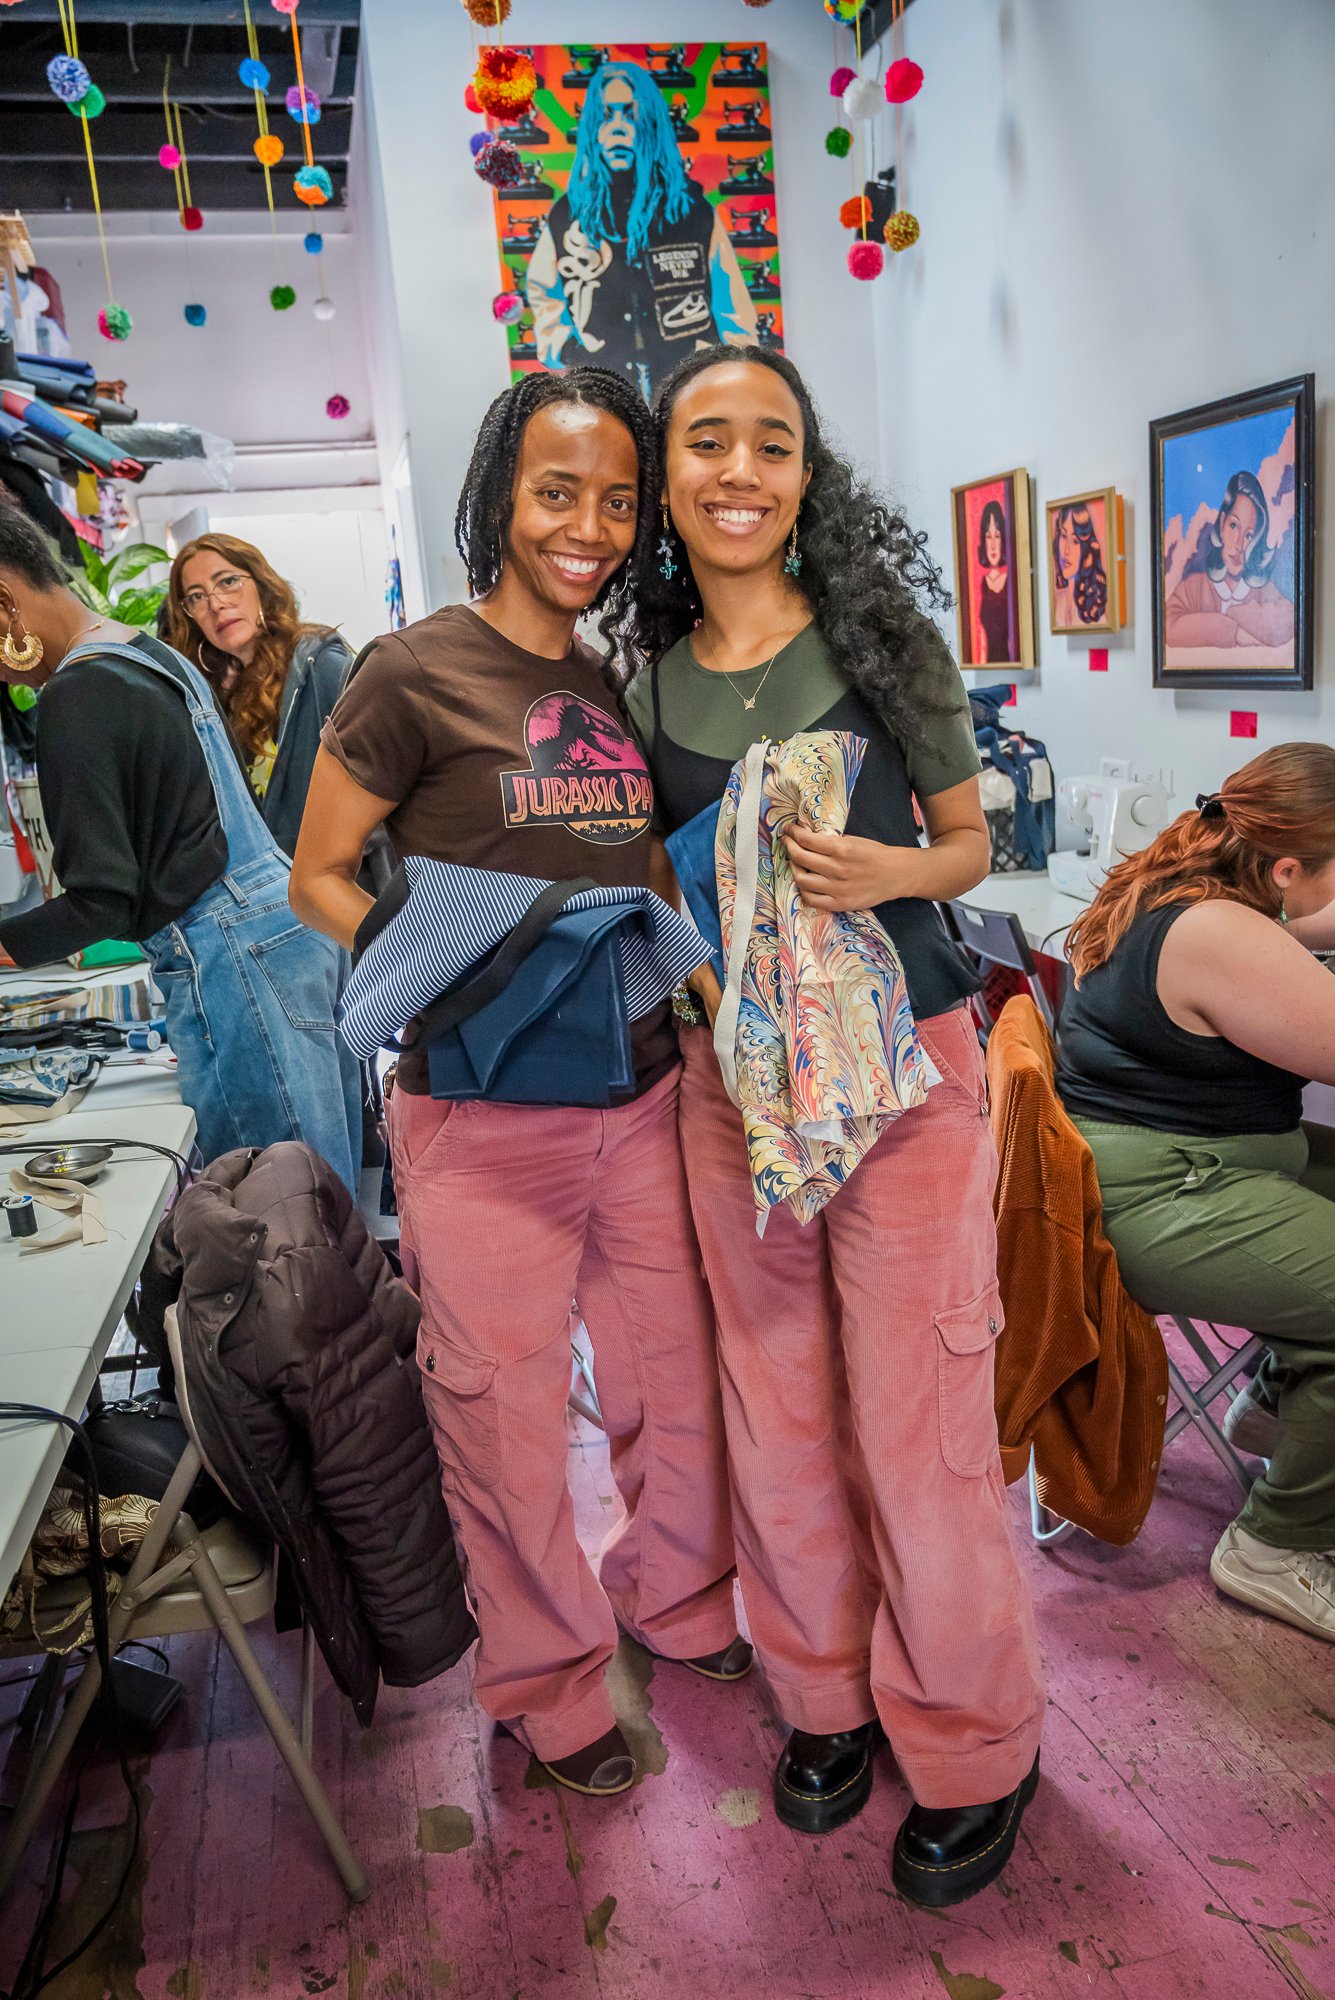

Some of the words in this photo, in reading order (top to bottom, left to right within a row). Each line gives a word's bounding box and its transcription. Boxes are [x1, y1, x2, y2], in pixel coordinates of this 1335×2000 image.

[652, 250, 698, 264] LEGENDS
[660, 260, 695, 272] NEVER
[509, 776, 624, 822] JURASSIC
[620, 772, 653, 815] PA
